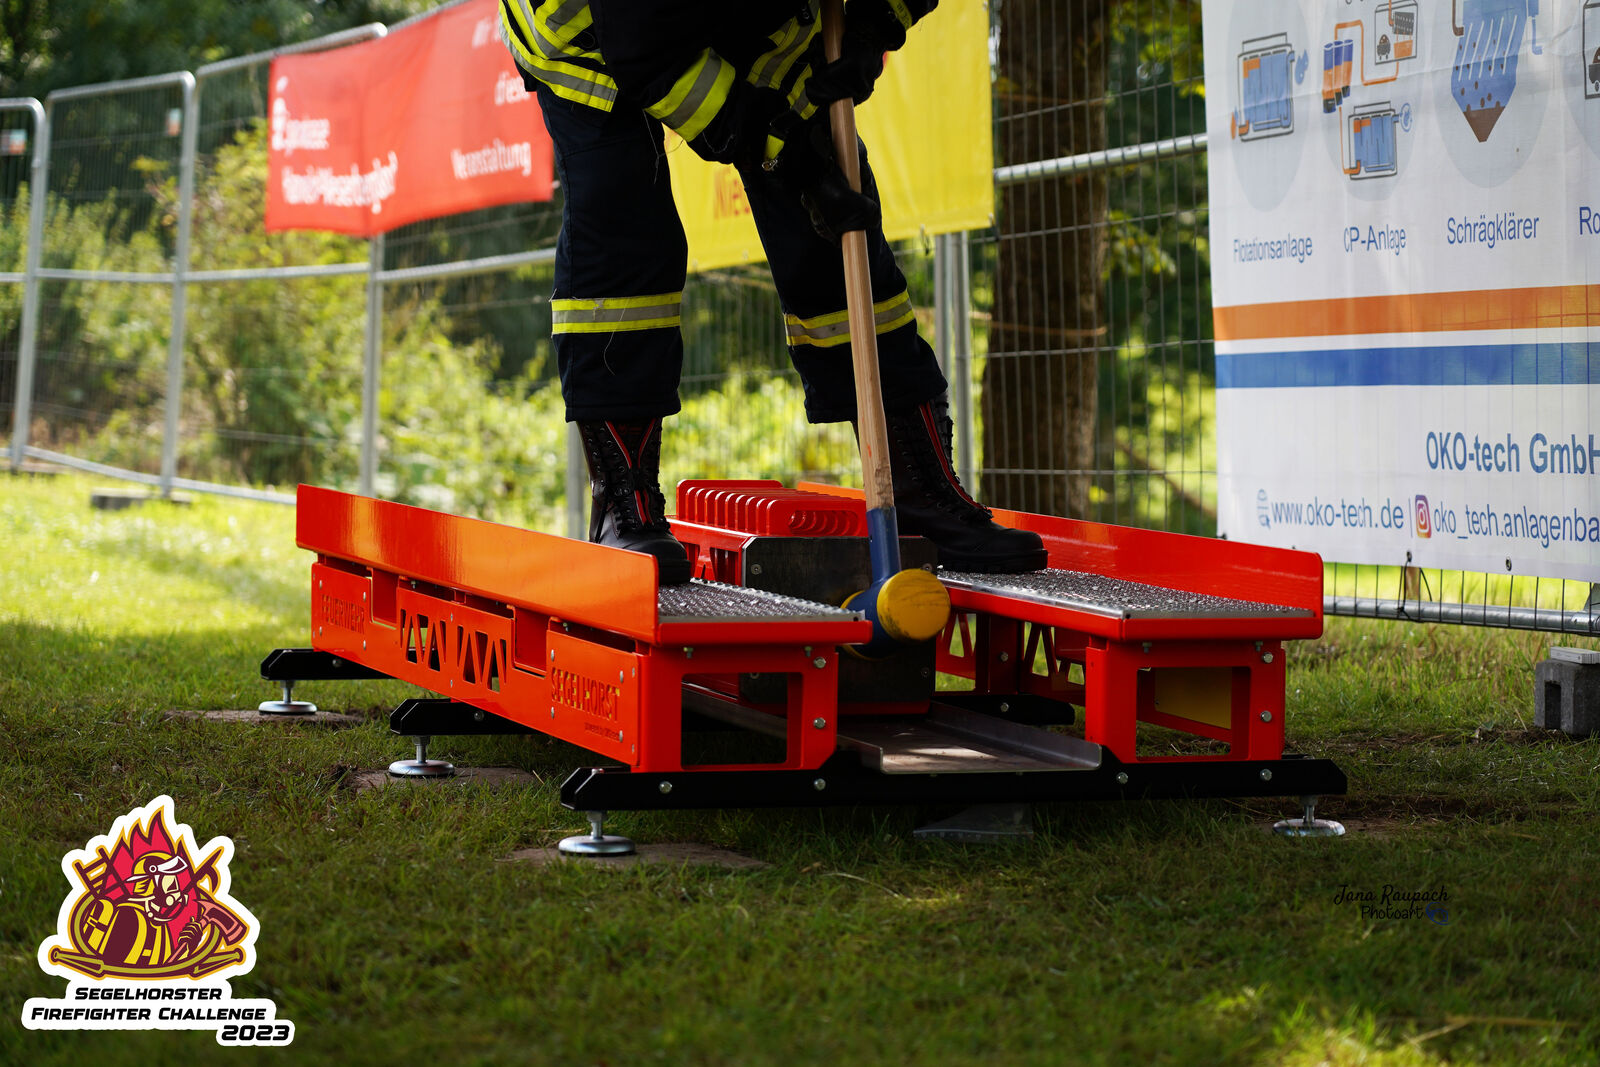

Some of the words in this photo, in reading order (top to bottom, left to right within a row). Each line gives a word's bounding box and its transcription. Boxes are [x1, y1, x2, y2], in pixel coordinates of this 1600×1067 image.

[450, 137, 532, 181] Veranstaltung
[1233, 232, 1313, 264] Flotationsanlage
[1343, 224, 1407, 256] CP-Anlage
[1446, 213, 1541, 249] Schrägklärer
[1426, 431, 1520, 473] OKO-tech
[1528, 433, 1600, 475] GmbH
[1271, 496, 1405, 530] www.oko-tech.de
[321, 593, 365, 636] FEUERWEHR
[551, 666, 621, 723] SEGELHORST
